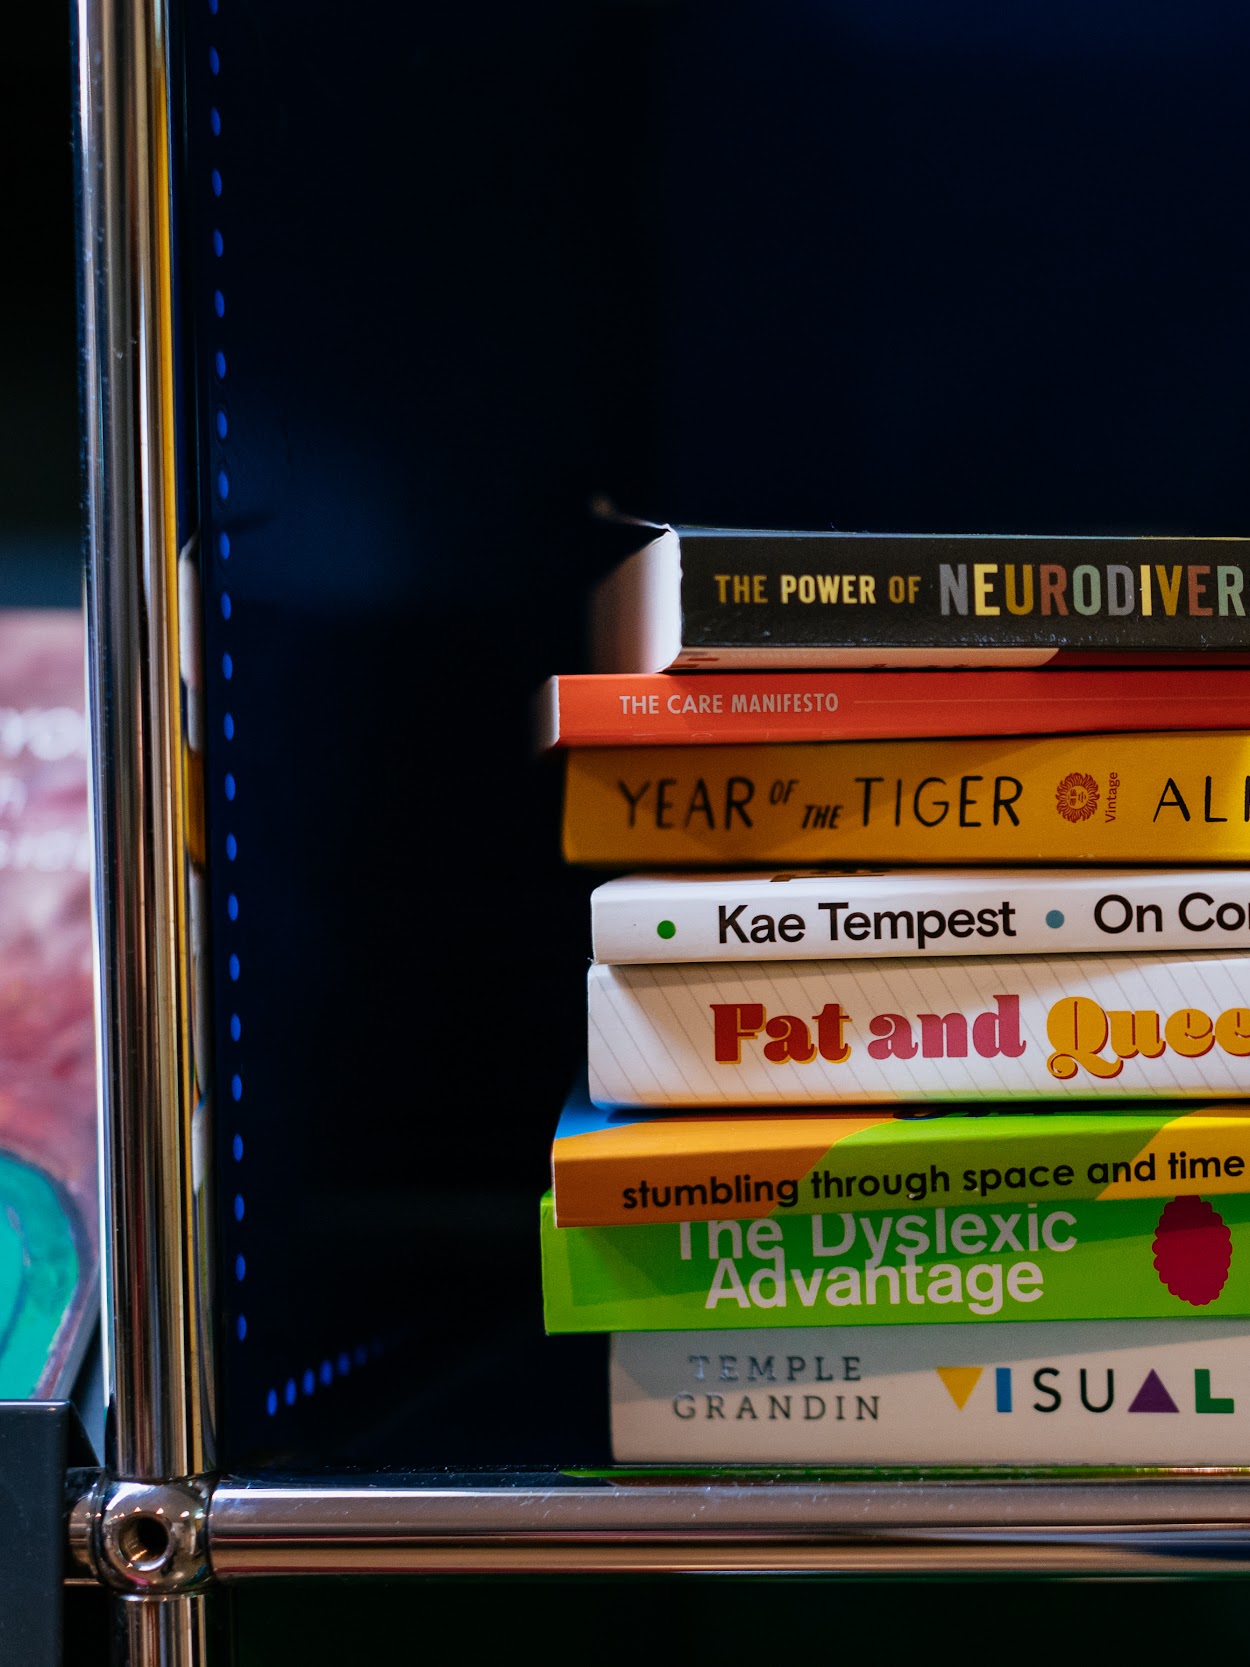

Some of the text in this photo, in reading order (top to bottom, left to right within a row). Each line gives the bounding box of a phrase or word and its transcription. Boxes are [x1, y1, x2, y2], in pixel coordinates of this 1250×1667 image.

[713, 574, 769, 604] THE
[780, 575, 876, 604] POWER
[889, 575, 921, 604] OF
[619, 692, 839, 715] THE CARE MANIFESTO
[617, 775, 1023, 830] YEAR OF THE TIGER
[1104, 771, 1120, 823] Vintage
[717, 900, 1017, 949] Kae Tempest
[1094, 894, 1163, 934] On
[710, 1002, 853, 1065] Fat
[867, 994, 1027, 1060] and
[622, 1151, 1245, 1208] stumbling through space and time
[811, 1204, 1077, 1267] Dyslexic
[705, 1246, 1045, 1315] Advantage
[690, 1356, 862, 1381] TEMPLE
[936, 1366, 1234, 1413] VISUAL
[672, 1392, 880, 1420] GRANDIN
